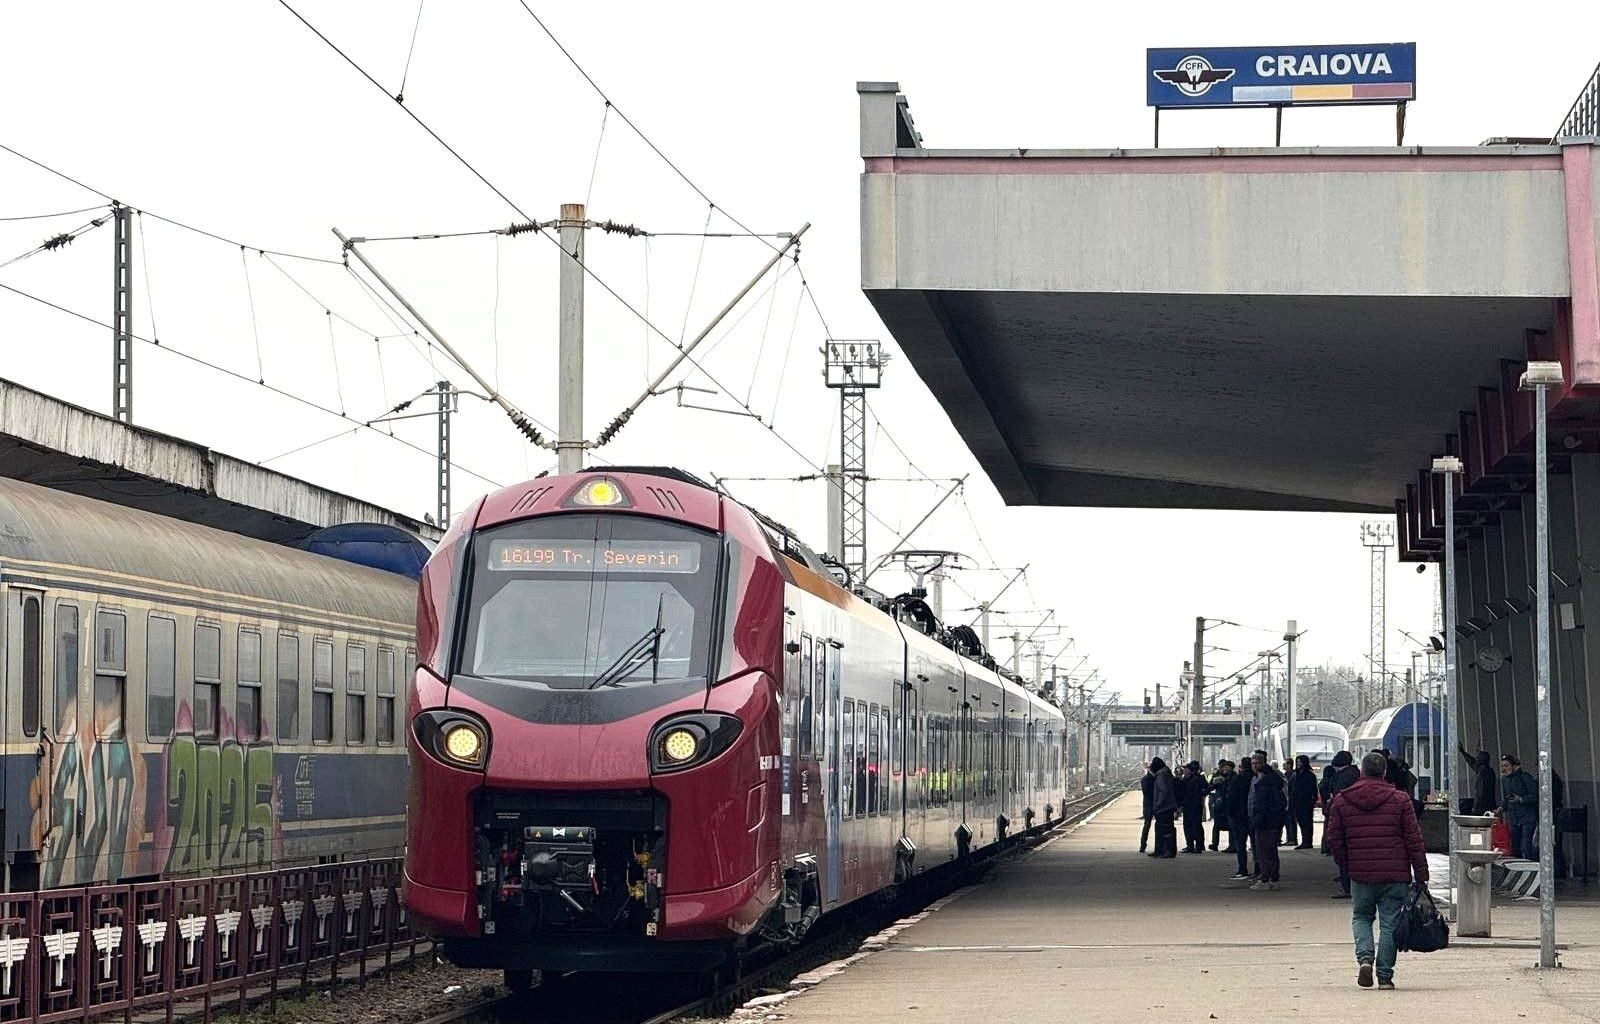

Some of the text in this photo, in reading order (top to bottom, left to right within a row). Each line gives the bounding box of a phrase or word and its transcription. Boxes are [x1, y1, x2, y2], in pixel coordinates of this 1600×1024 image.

[1185, 62, 1203, 70] CFR
[1255, 53, 1393, 77] CRAIOVA
[501, 549, 679, 566] 16199 Tr. Severin
